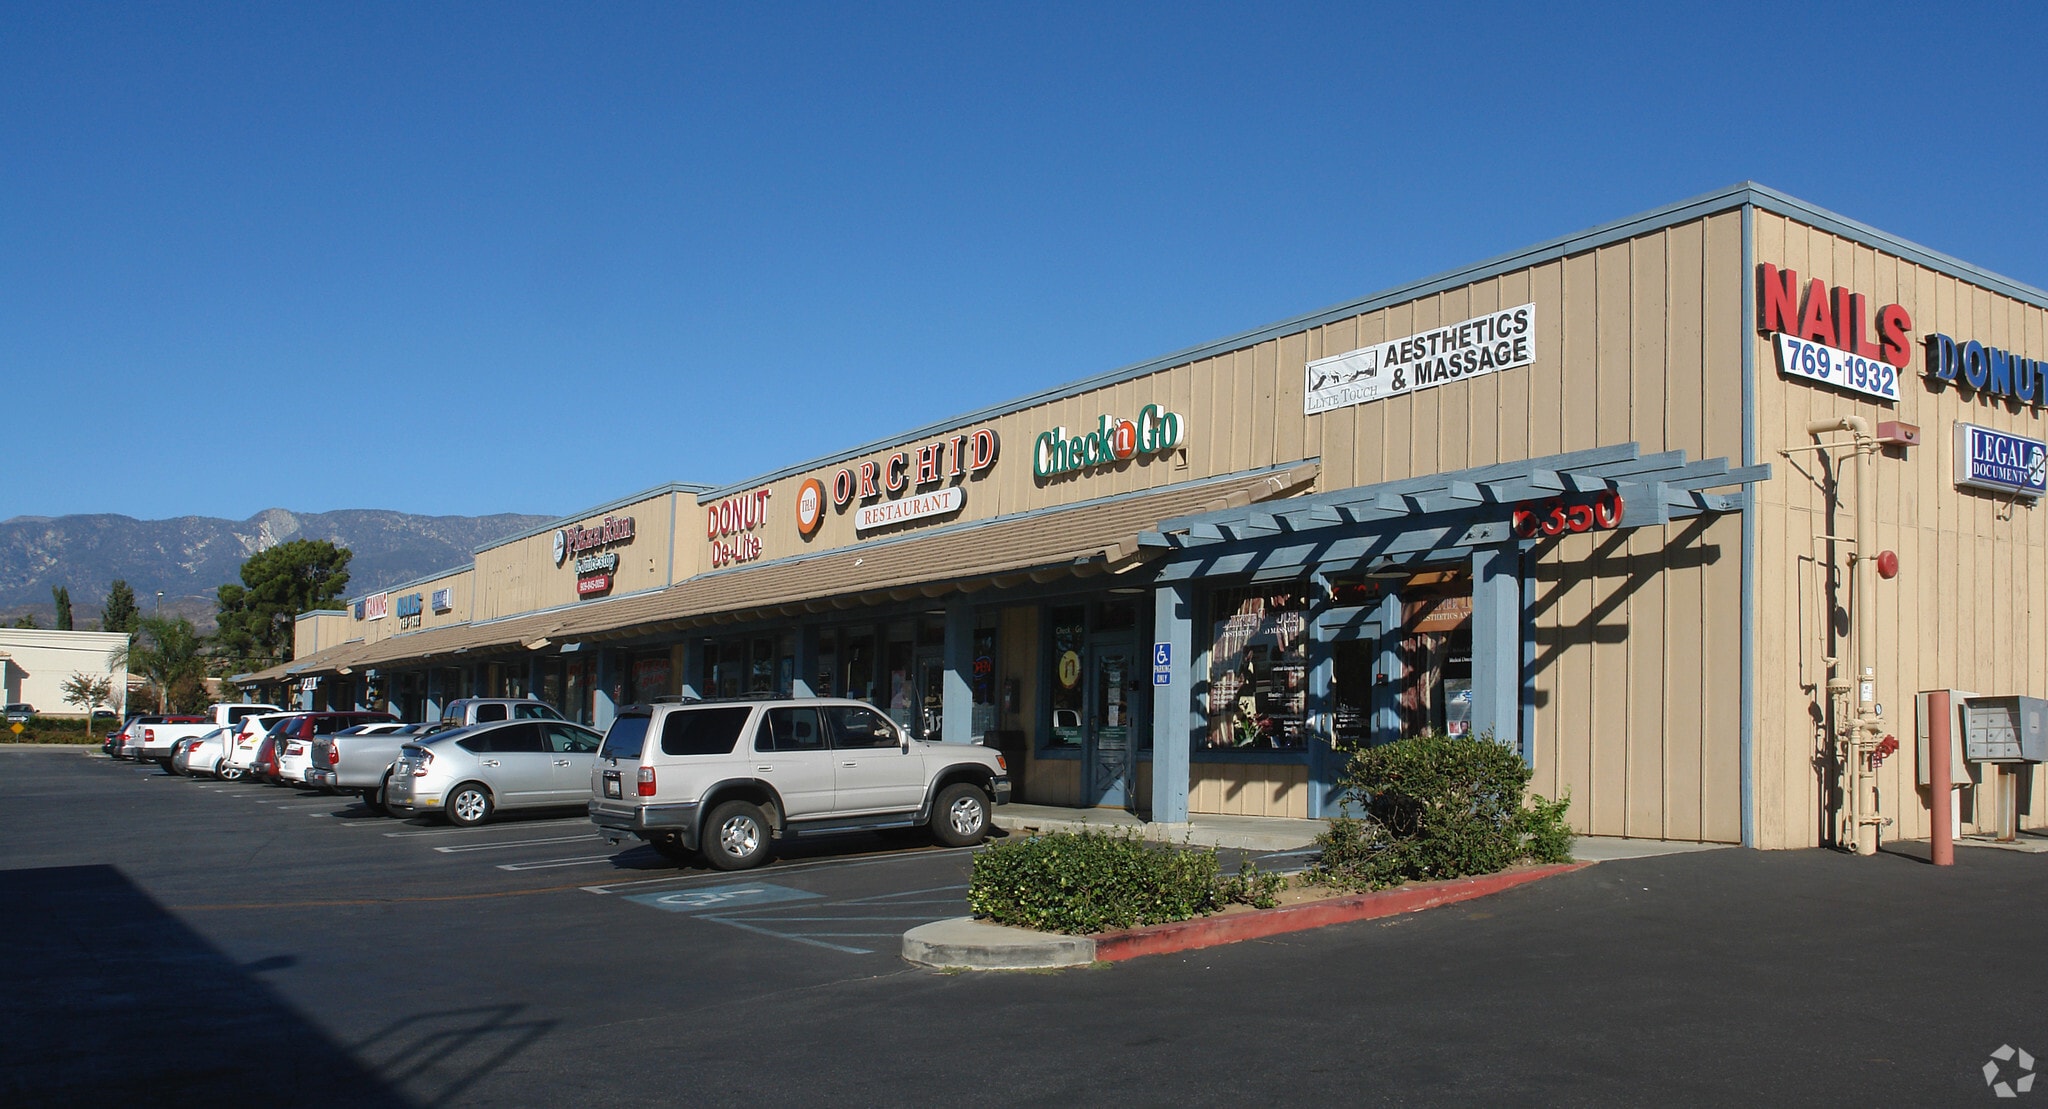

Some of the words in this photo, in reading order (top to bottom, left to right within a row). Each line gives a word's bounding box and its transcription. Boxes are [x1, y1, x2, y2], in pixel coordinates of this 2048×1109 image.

[1759, 262, 1912, 368] NAILS
[1384, 309, 1528, 368] AESTHETICS
[1391, 367, 1407, 391] &
[1415, 337, 1528, 386] MASSAGE
[1787, 339, 1895, 396] 769-1932
[1307, 394, 1340, 411] LLYTE
[1341, 385, 1378, 404] TOUCH
[1034, 414, 1115, 477] Check
[1137, 403, 1179, 454] Go
[1973, 431, 2028, 469] LEGAL
[833, 428, 995, 506] ORCHID
[1973, 461, 2029, 483] DOCUMENTS
[708, 489, 769, 539] DONUT
[802, 497, 816, 513] THAI
[864, 492, 951, 525] RESTAURANT
[566, 525, 602, 553] Pizza
[601, 515, 632, 544] Run
[713, 533, 762, 566] De-Lite
[1157, 674, 1168, 683] ONLY
